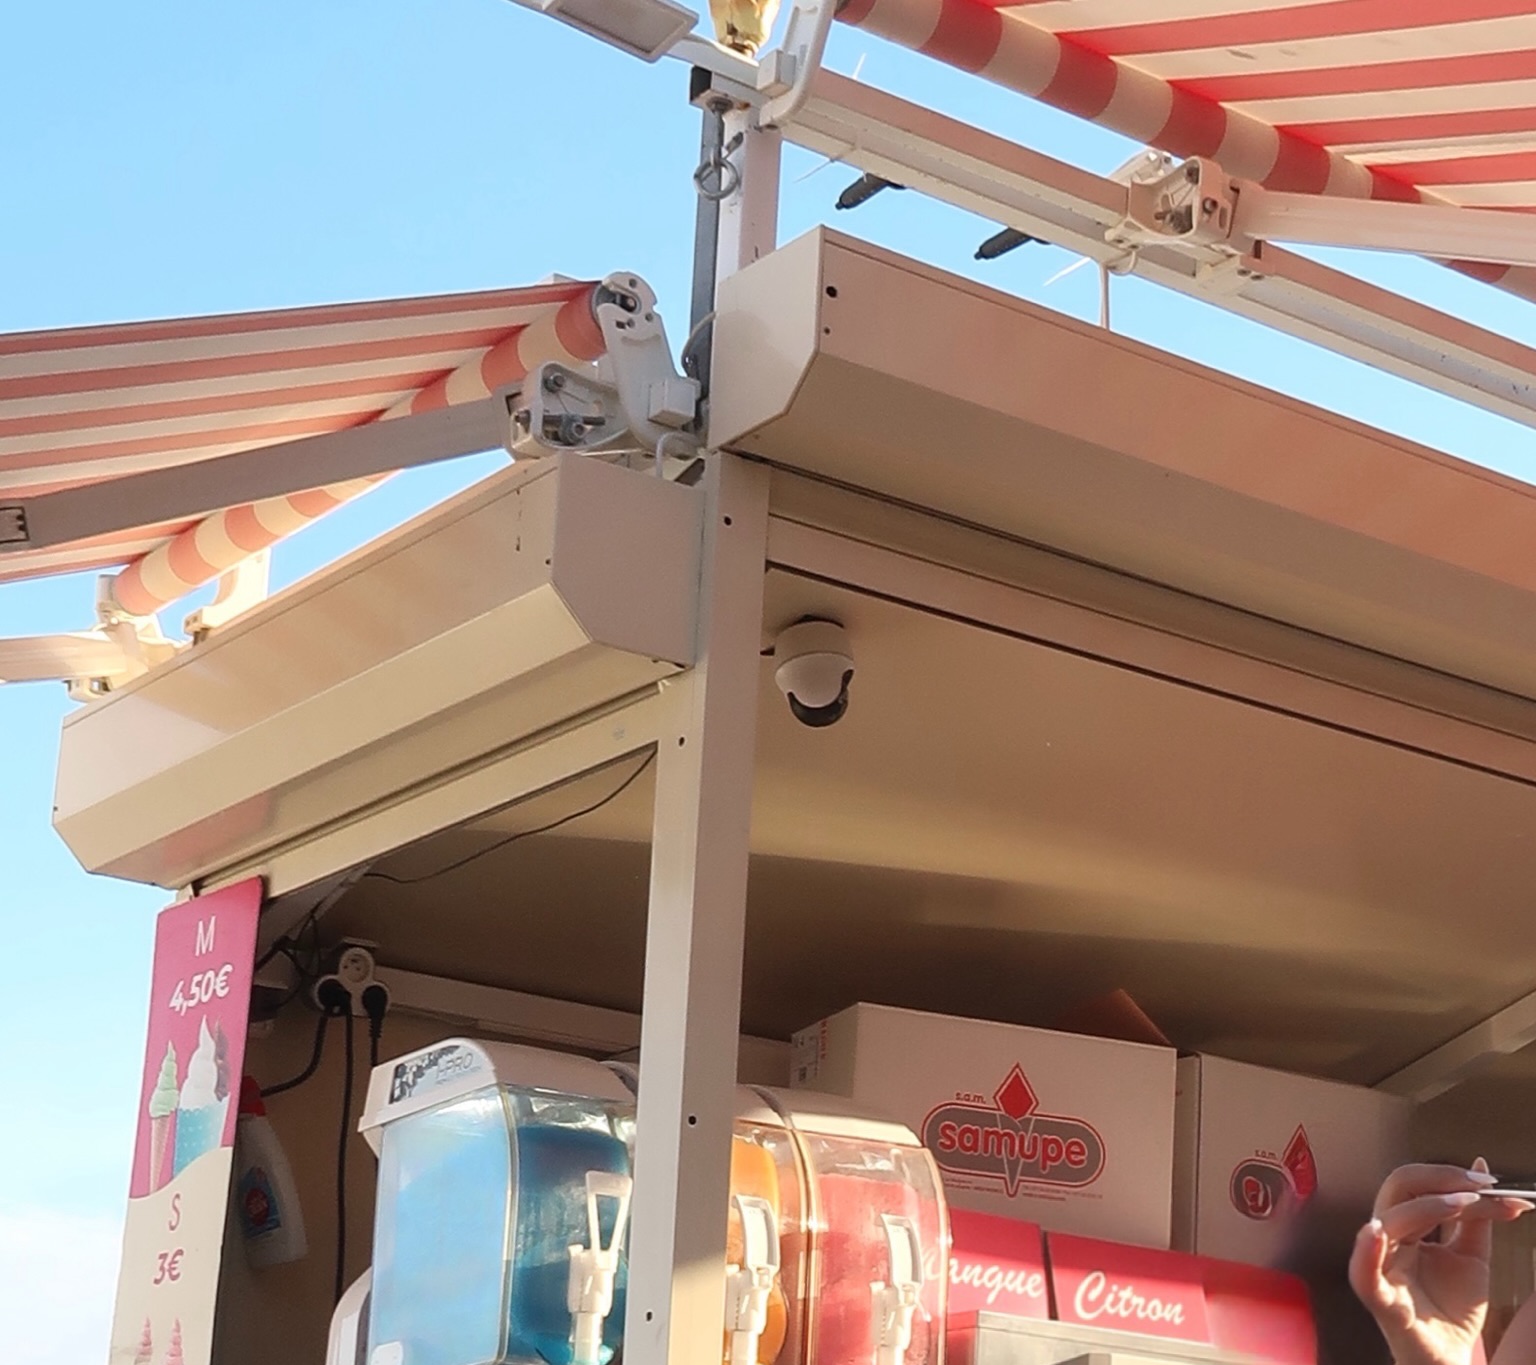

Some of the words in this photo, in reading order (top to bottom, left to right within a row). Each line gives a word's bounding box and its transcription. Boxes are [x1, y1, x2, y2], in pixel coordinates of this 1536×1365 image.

[195, 916, 216, 957] M
[168, 963, 234, 1017] 4,50€
[938, 1120, 1089, 1175] samupe
[168, 1192, 181, 1232] S
[153, 1248, 184, 1285] 3€
[1074, 1270, 1185, 1326] Citron
